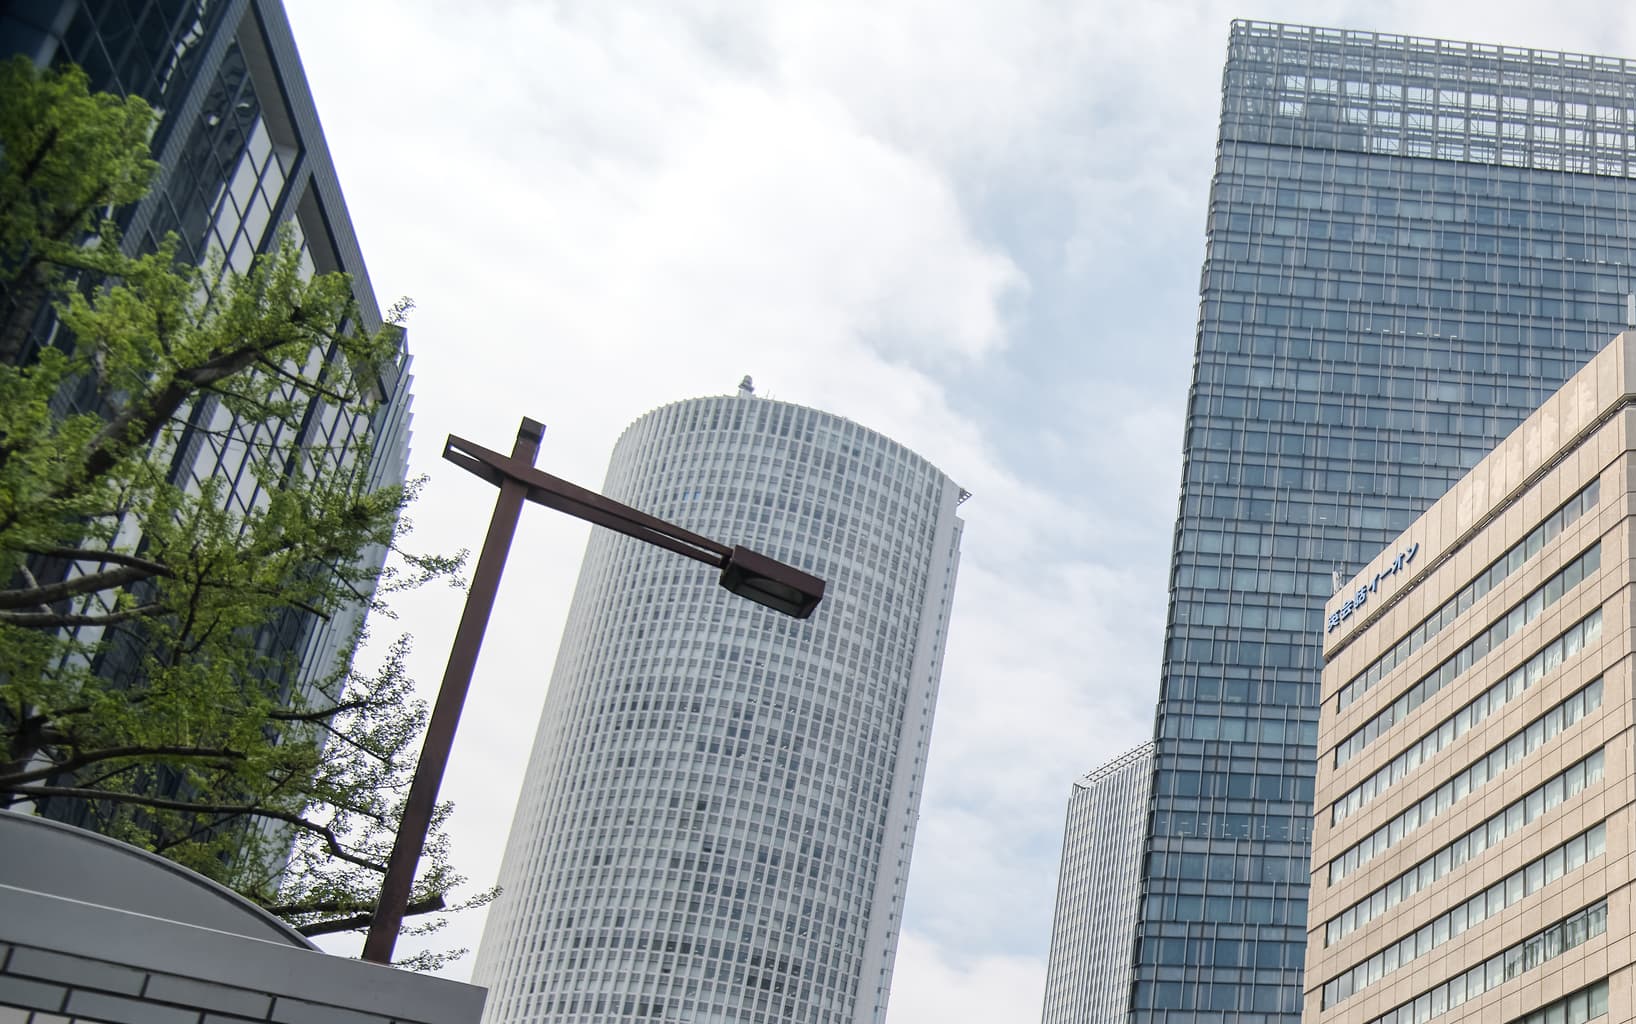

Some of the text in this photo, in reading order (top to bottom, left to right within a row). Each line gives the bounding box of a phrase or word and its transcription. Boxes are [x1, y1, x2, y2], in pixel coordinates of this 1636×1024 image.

[1327, 542, 1420, 633] 英会話イーオン
